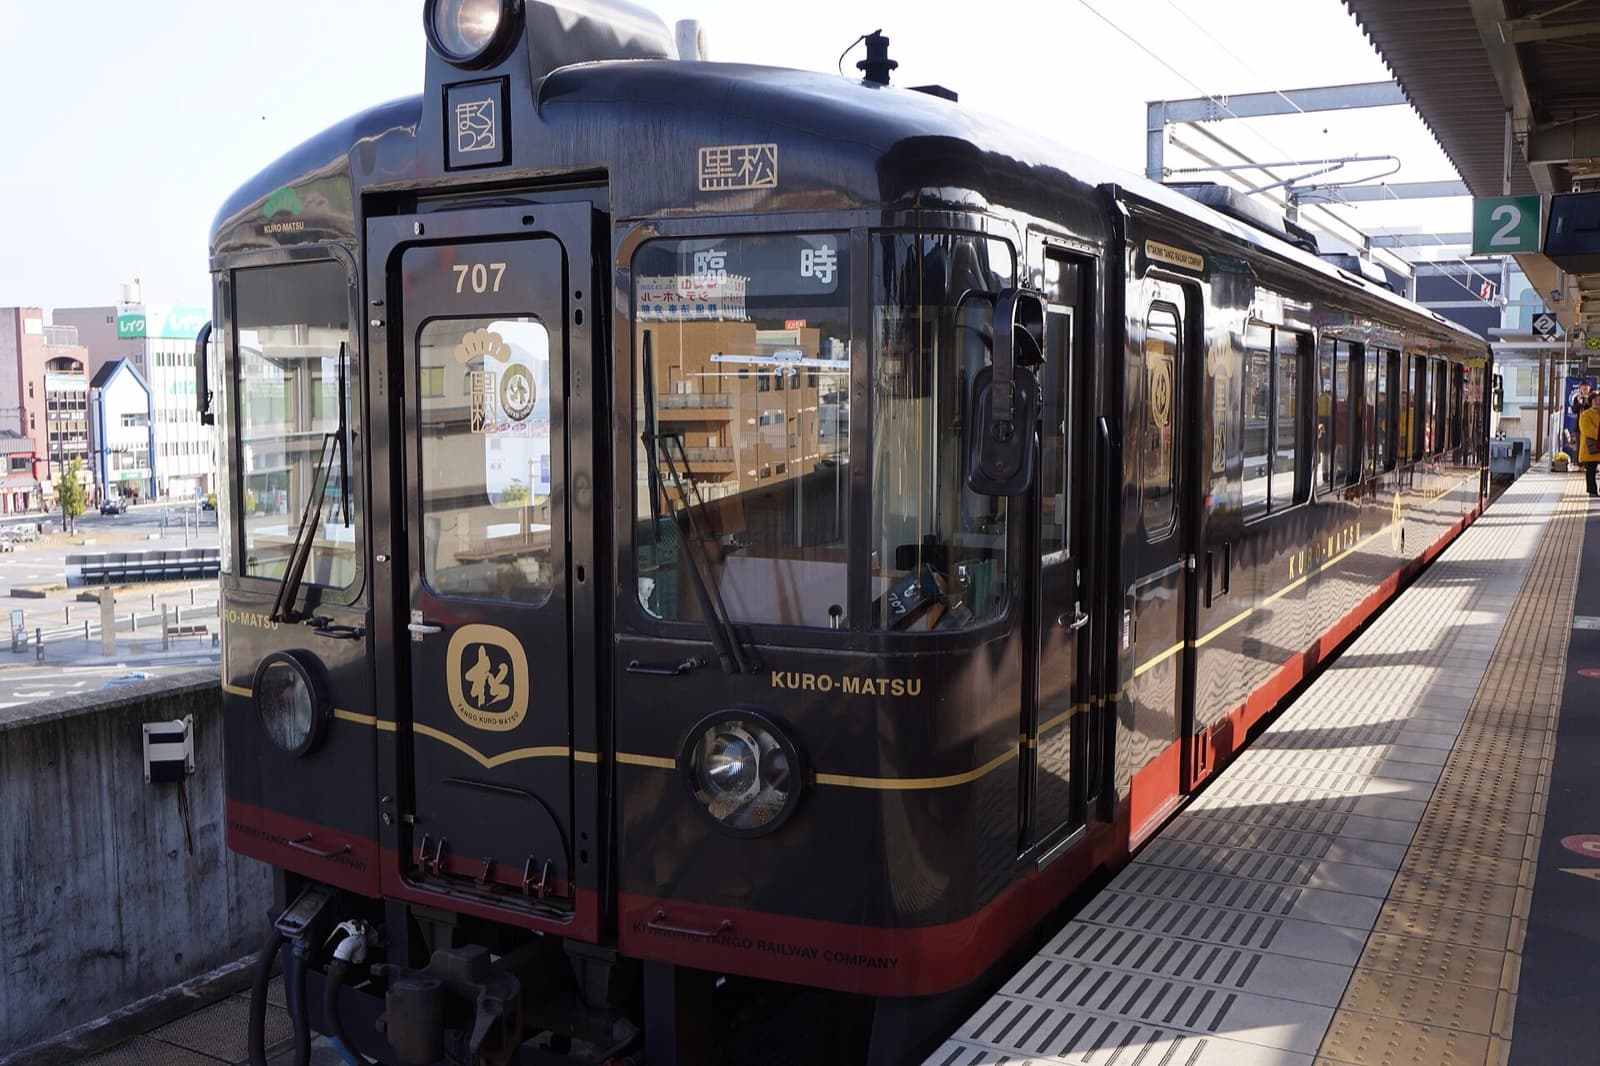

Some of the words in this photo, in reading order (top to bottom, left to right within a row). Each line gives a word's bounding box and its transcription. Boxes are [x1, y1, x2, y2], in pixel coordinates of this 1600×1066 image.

[700, 144, 777, 190] 黒松
[1490, 205, 1521, 246] 2
[452, 262, 507, 294] 707
[800, 245, 837, 284] 時
[120, 320, 145, 332] レイク
[1539, 318, 1549, 330] 2
[771, 670, 922, 697] KURO-MATSU
[457, 703, 478, 721] TANGO
[756, 939, 819, 960] RAILWAY
[824, 949, 898, 968] COMPANY
